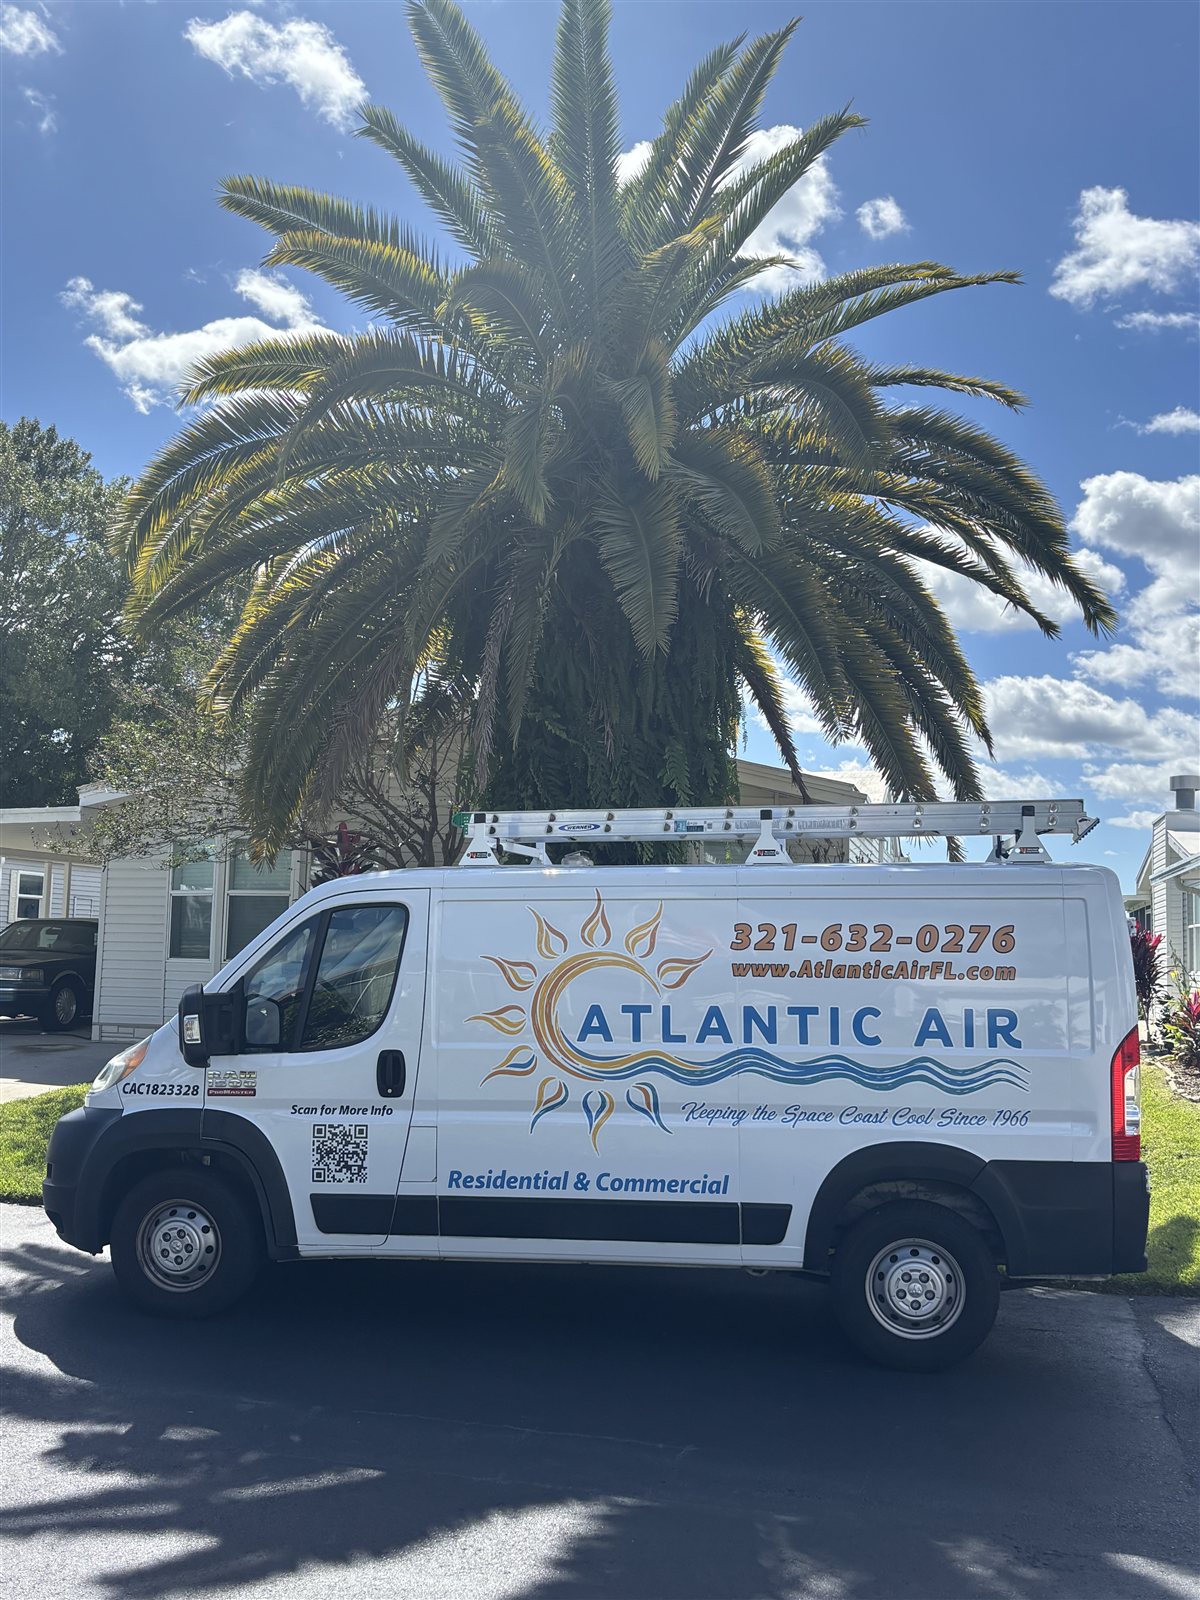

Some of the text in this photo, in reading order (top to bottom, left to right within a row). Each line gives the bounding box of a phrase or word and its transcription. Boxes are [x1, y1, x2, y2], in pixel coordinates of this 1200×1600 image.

[730, 923, 1016, 953] 321-632-0276
[731, 959, 1017, 981] www.AtlanticAirFL.com
[576, 1004, 1022, 1049] ATLANTIC AIR
[207, 1070, 257, 1079] RAM
[207, 1079, 257, 1087] 1500
[122, 1082, 200, 1096] CAC1823328
[290, 1104, 393, 1117] Scan for More Info
[681, 1101, 1031, 1128] Keeping the Space Coast Cool Since 1966
[448, 1169, 730, 1195] Residential & Commercial
